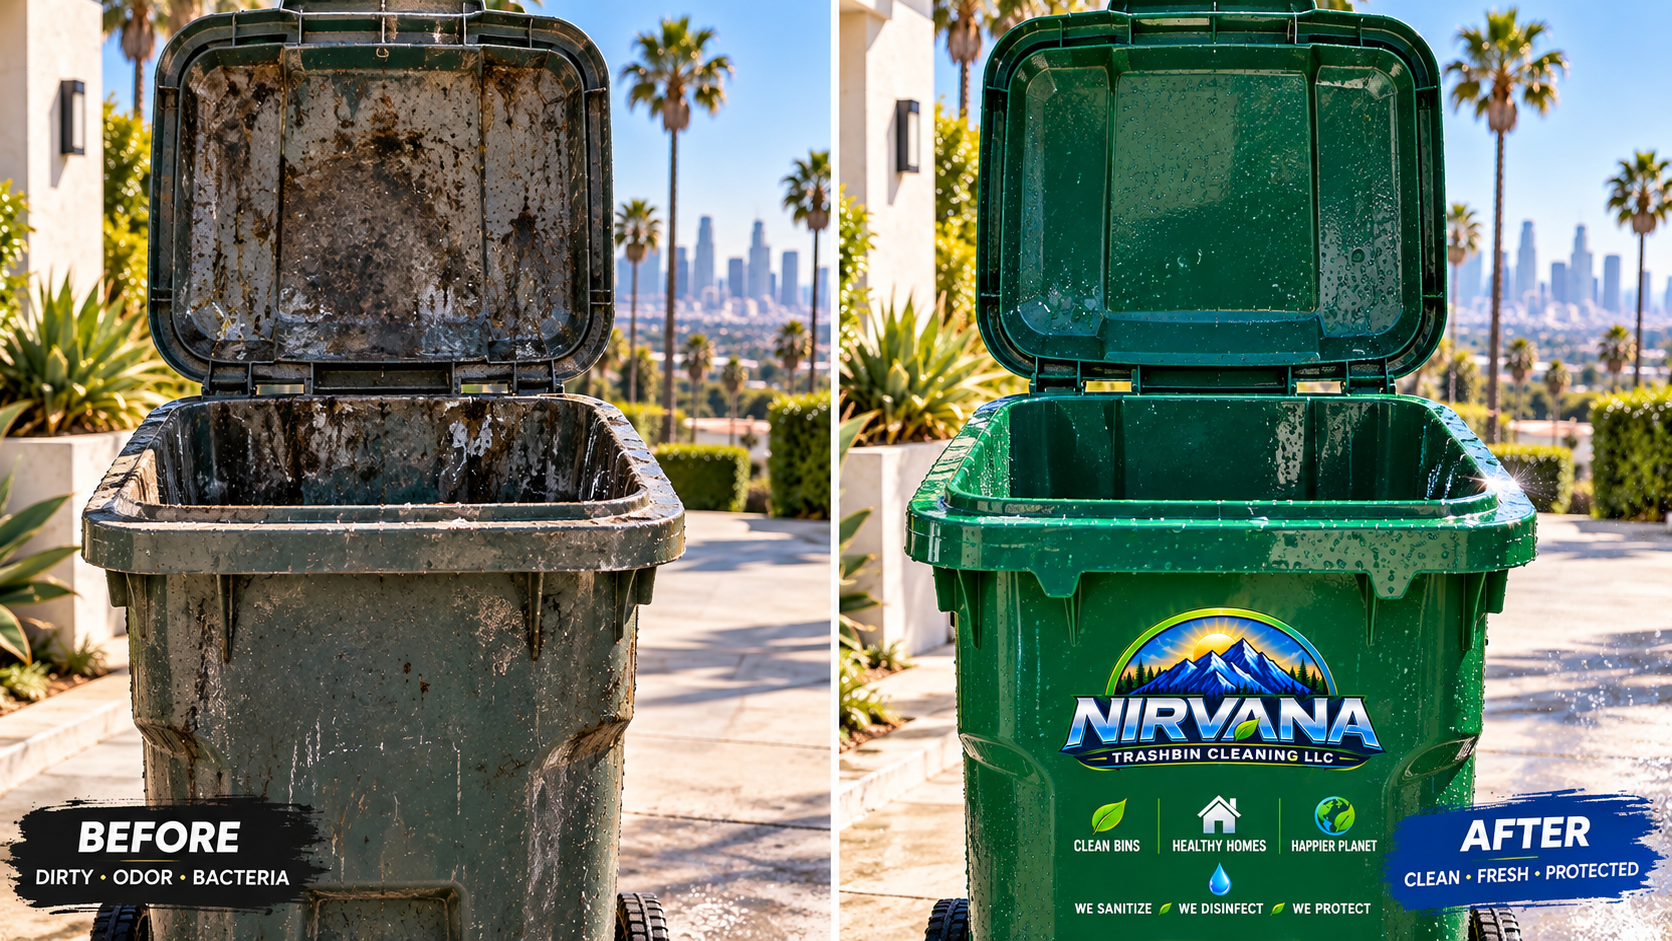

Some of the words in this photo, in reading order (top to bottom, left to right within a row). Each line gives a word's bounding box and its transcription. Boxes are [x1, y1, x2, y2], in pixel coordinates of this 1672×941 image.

[1062, 696, 1383, 748] NIRVANA
[1112, 748, 1201, 764] TRASHBIN
[1207, 748, 1298, 762] CLEANING
[1304, 750, 1334, 764] LLC
[1073, 839, 1110, 852] CLEAN
[1113, 839, 1140, 852] BINS
[1172, 839, 1223, 852] HEALTHY
[1226, 839, 1267, 852] HOMES
[1291, 839, 1336, 852] HAPPIER
[1338, 839, 1378, 852] PLANET
[1074, 902, 1093, 914] WE
[1097, 902, 1152, 914] SANITIZE
[1178, 902, 1198, 914] WE
[1201, 902, 1264, 914] DISINFECT
[1292, 902, 1311, 914] WE
[1315, 902, 1371, 914] PROTECT
